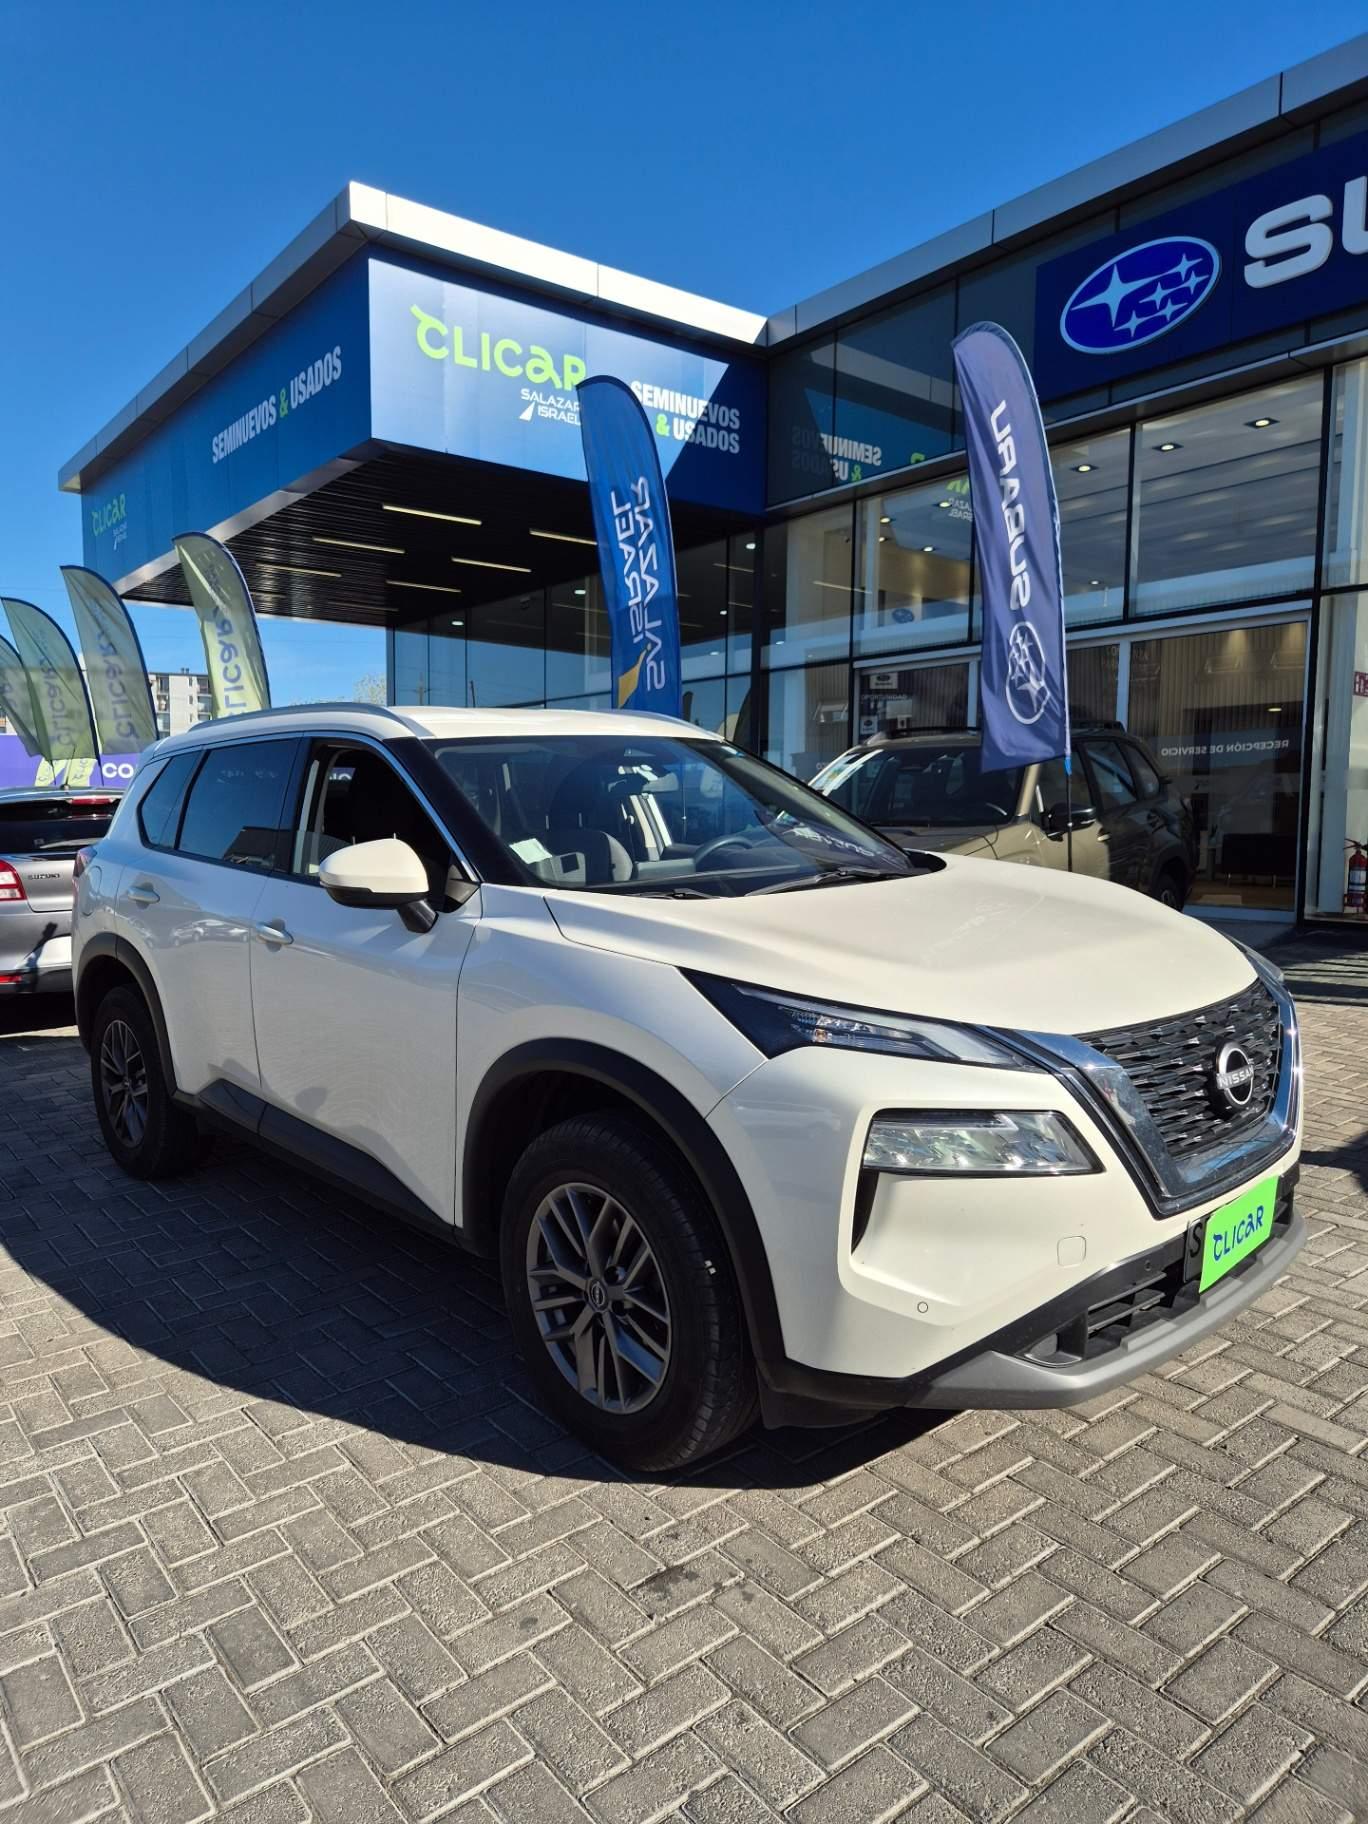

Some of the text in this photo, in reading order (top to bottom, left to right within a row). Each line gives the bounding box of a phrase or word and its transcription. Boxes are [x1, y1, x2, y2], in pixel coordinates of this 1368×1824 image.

[212, 345, 342, 464] SEMINUEVOS & USADOS
[521, 388, 581, 413] SALAZAR
[537, 405, 582, 426] ISRAEL
[630, 380, 740, 430] SEMINUEVOS
[656, 414, 740, 454] & USADOS
[1218, 1066, 1254, 1088] NISSAN
